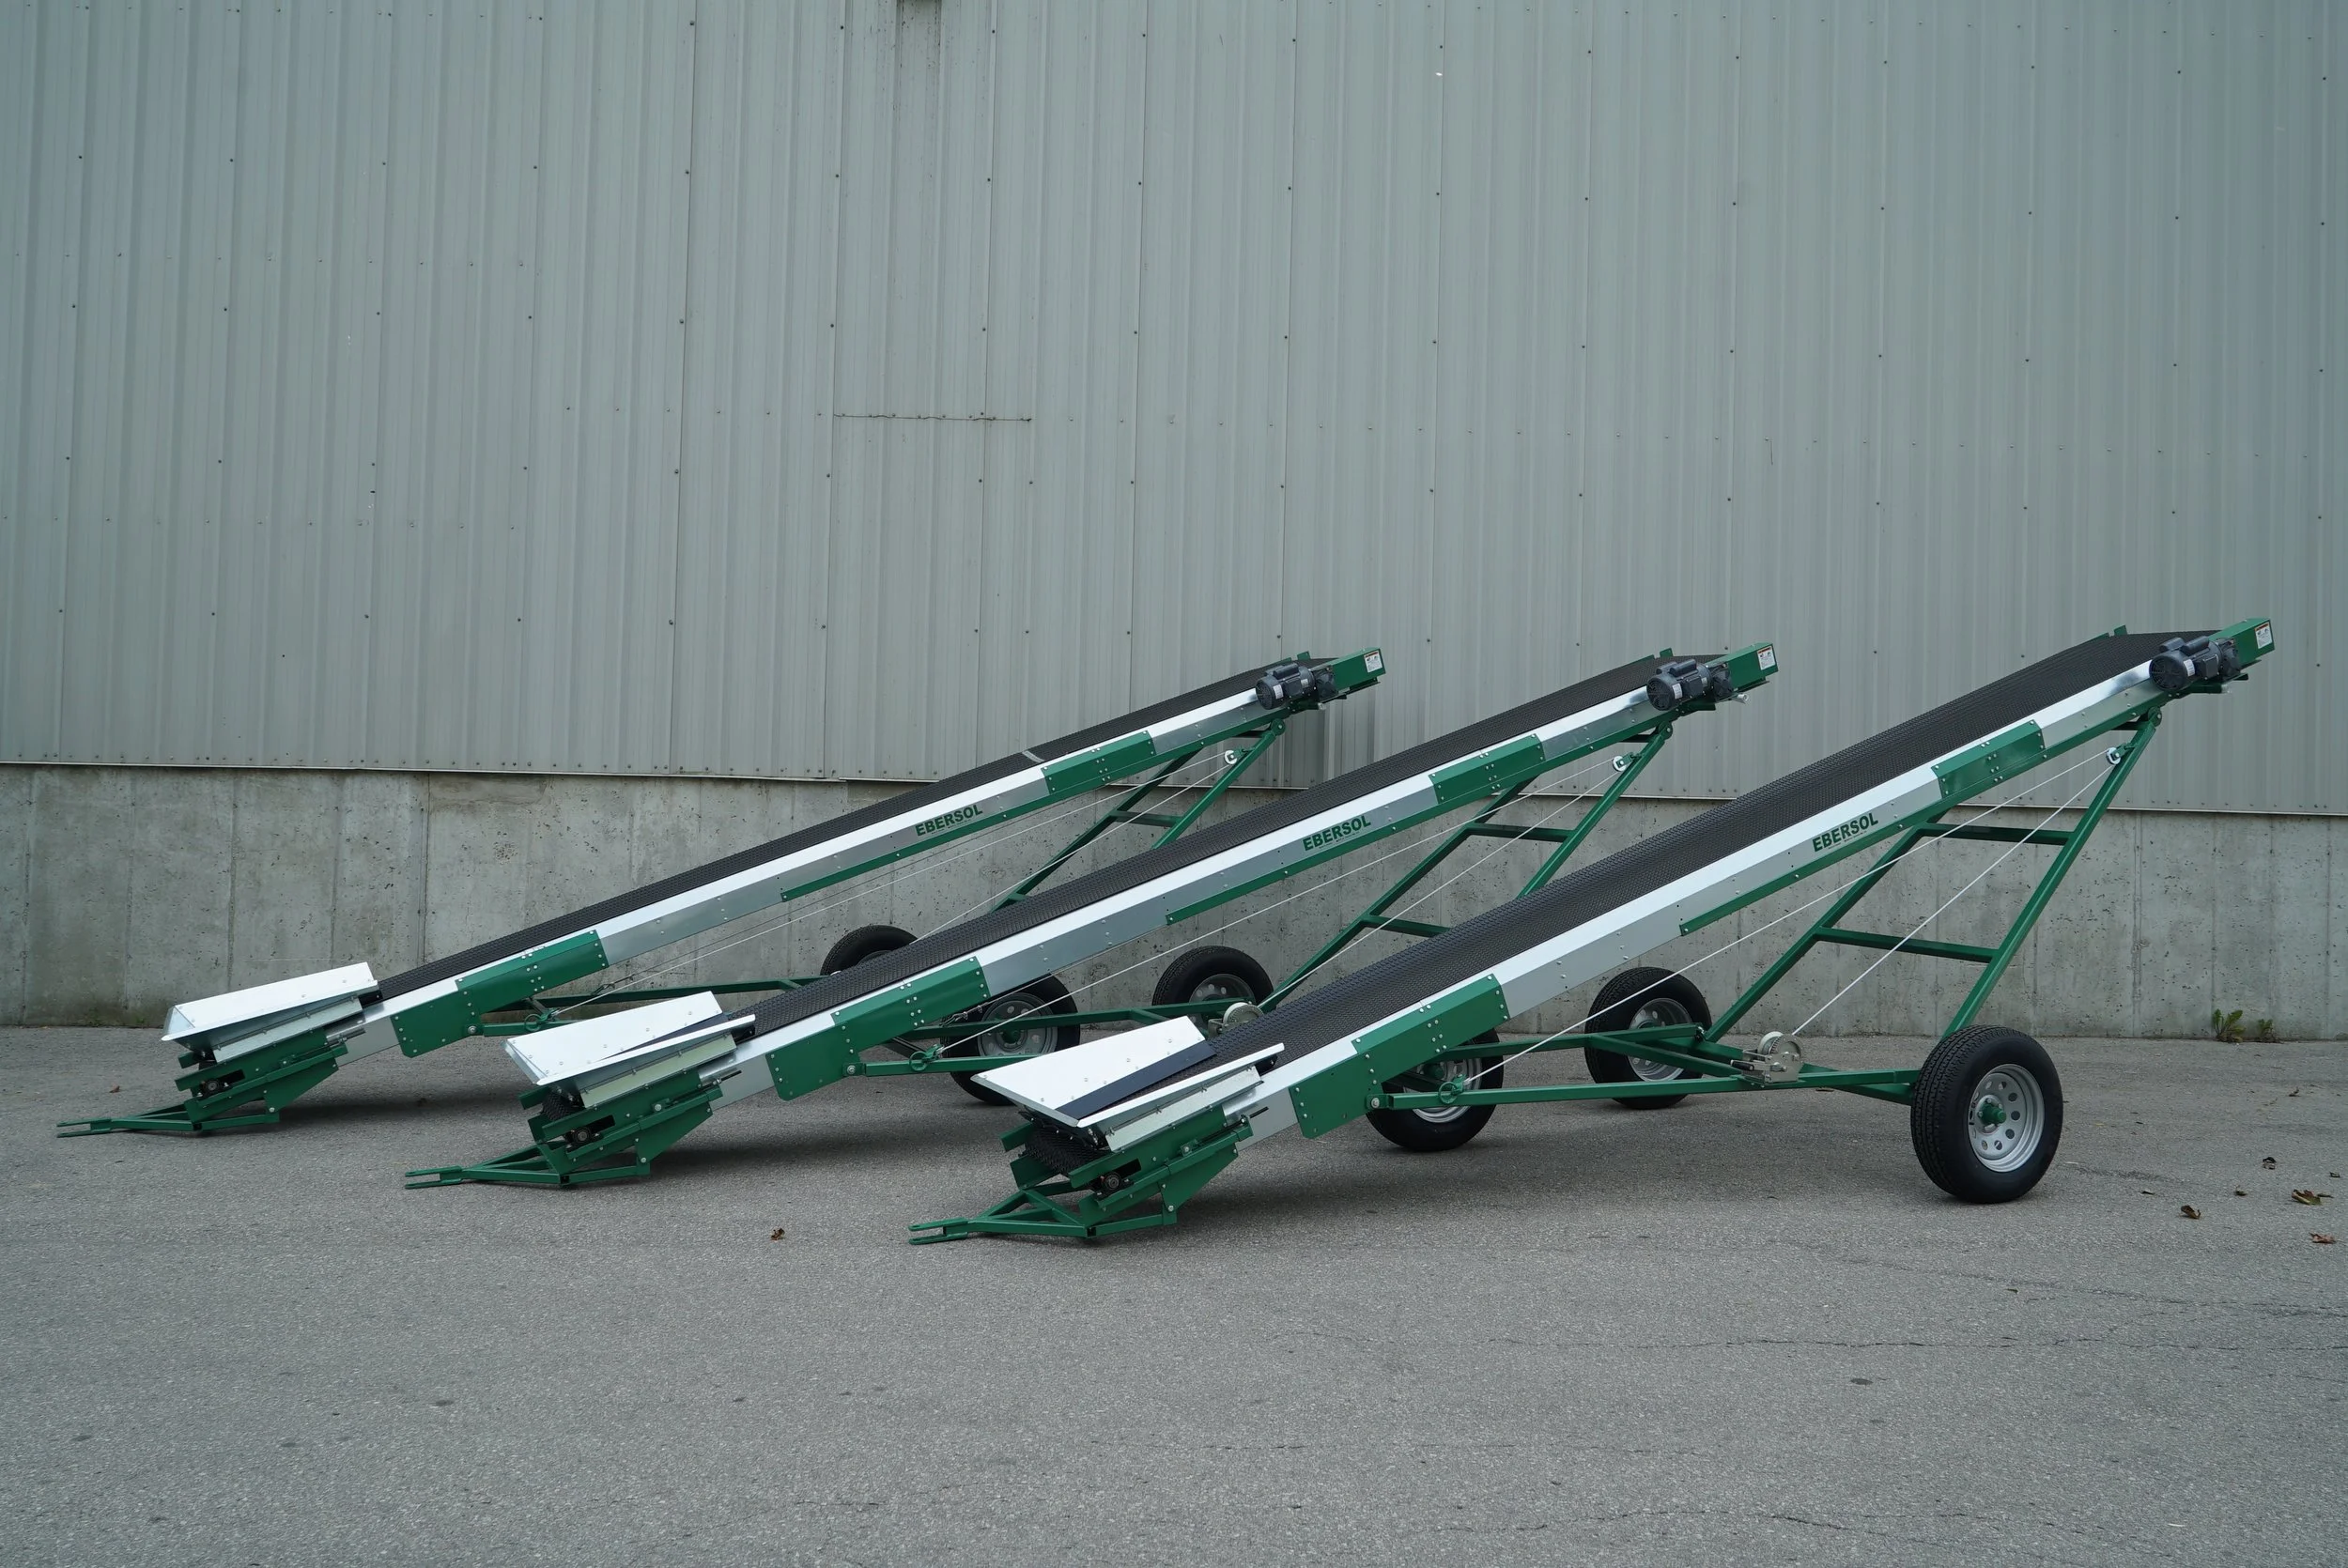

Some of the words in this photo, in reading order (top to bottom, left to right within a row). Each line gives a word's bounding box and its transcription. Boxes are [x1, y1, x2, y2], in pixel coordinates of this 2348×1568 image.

[916, 805, 982, 836] EBERSOL
[1303, 816, 1370, 851] EBERSOL
[1813, 813, 1878, 852] EBERSOL
